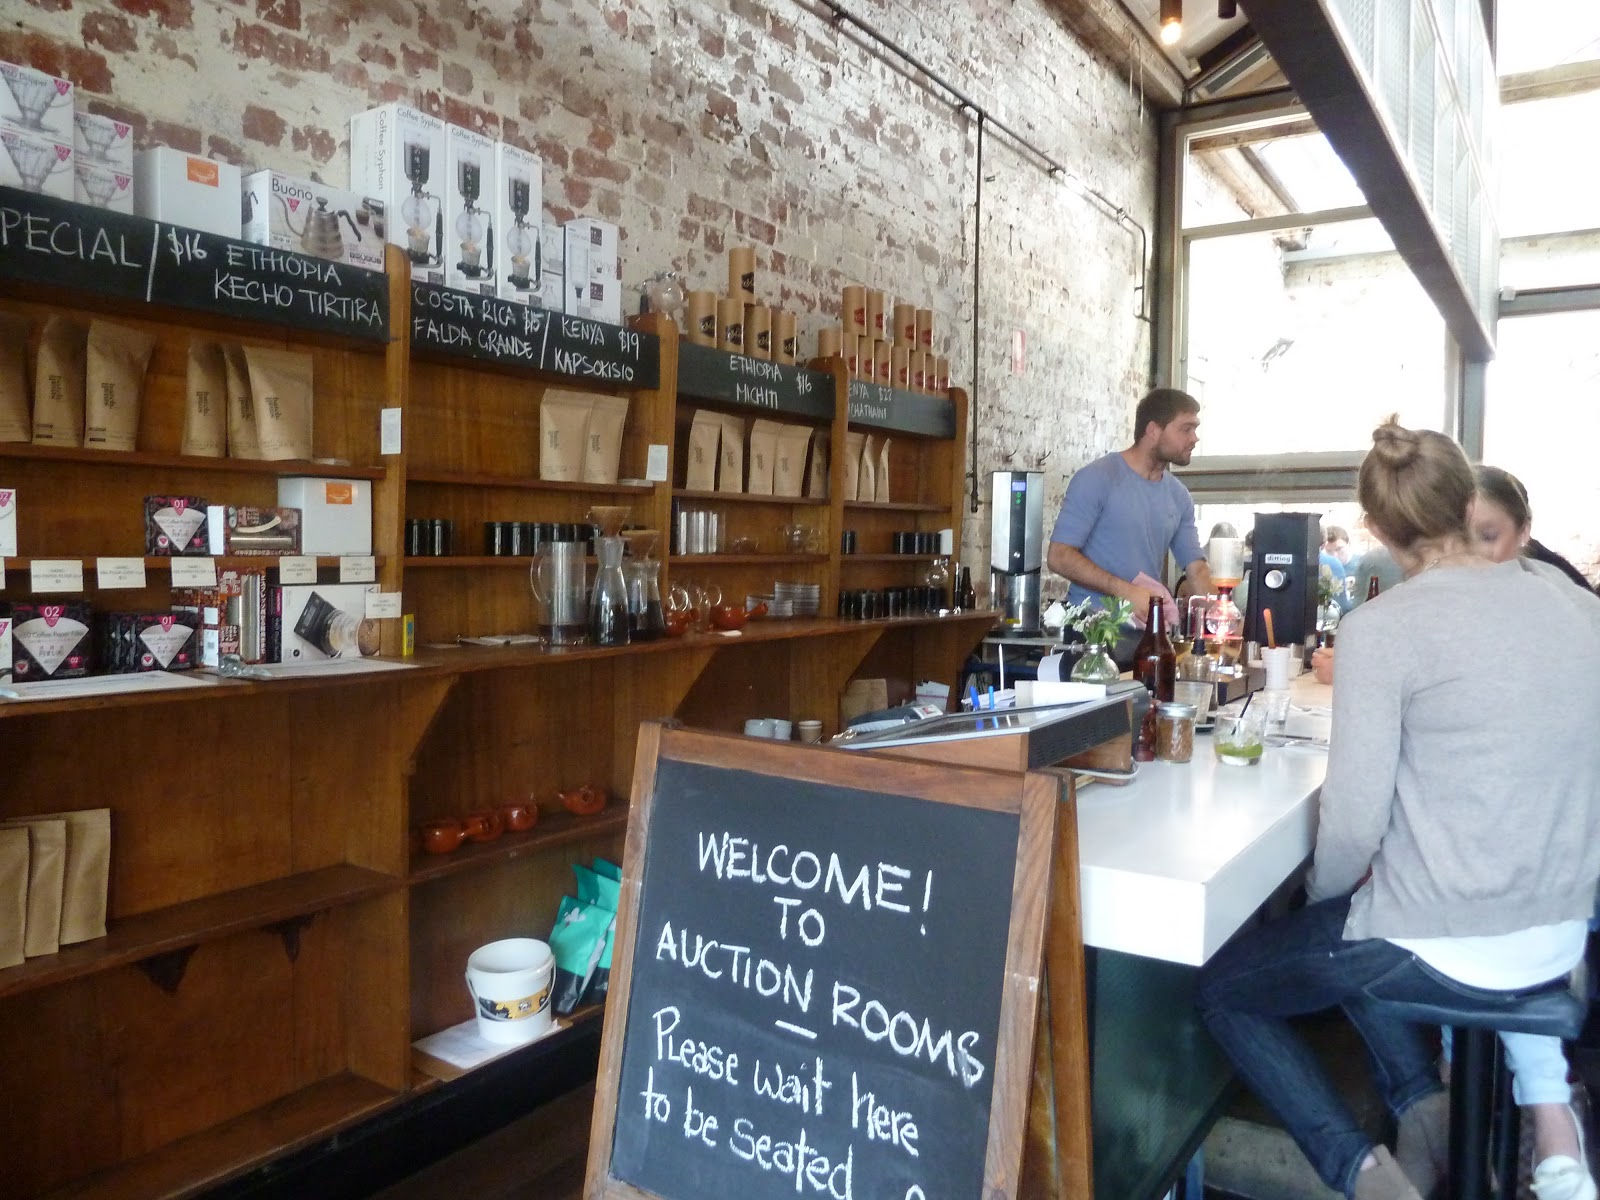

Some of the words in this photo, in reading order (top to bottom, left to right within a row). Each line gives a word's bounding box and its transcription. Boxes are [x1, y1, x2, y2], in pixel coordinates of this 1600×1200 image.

[396, 107, 418, 122] Coffee
[451, 127, 470, 140] Coffee
[271, 177, 313, 201] Buono
[168, 228, 208, 265] $16
[227, 244, 342, 287] ETHIOPIA
[214, 268, 293, 307] KECHO
[299, 288, 383, 327] TIRTIRA
[414, 286, 474, 319] COSTA
[482, 299, 516, 327] RICA
[562, 315, 604, 346] KENYA
[618, 327, 639, 360] $19
[414, 316, 472, 347] FALDA
[478, 329, 533, 359] GRANDE
[730, 354, 783, 382] ETHIOPIA
[796, 372, 812, 396] $16
[174, 500, 184, 509] 01
[44, 606, 60, 617] 02
[162, 616, 172, 625] 01
[774, 896, 825, 947] TO
[656, 921, 814, 1013] AUCTION
[832, 981, 985, 1088] ROOMS
[640, 1066, 671, 1122] to
[684, 1086, 719, 1147] be
[852, 1071, 919, 1157] here
